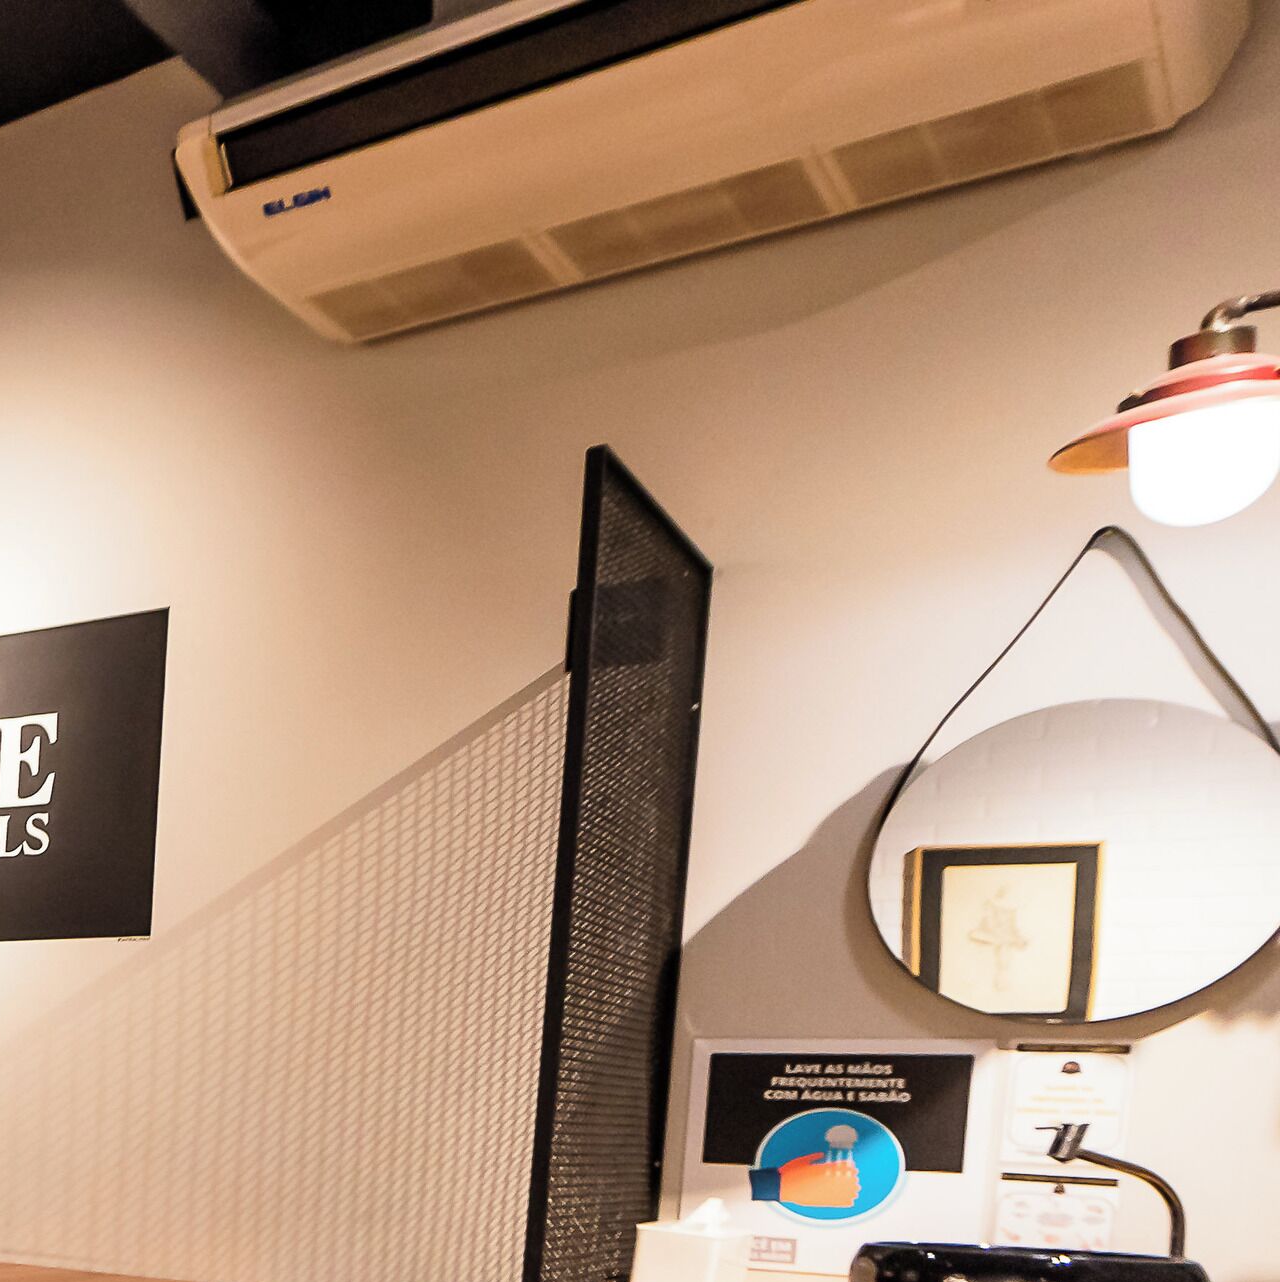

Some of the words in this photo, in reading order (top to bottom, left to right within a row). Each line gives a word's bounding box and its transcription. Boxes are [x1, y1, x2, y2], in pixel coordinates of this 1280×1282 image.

[785, 1063, 822, 1075] LAVE
[824, 1063, 844, 1075] AS
[770, 1076, 906, 1089] FREQUENTEMENTE
[763, 1089, 798, 1102] COM
[846, 1090, 855, 1102] E
